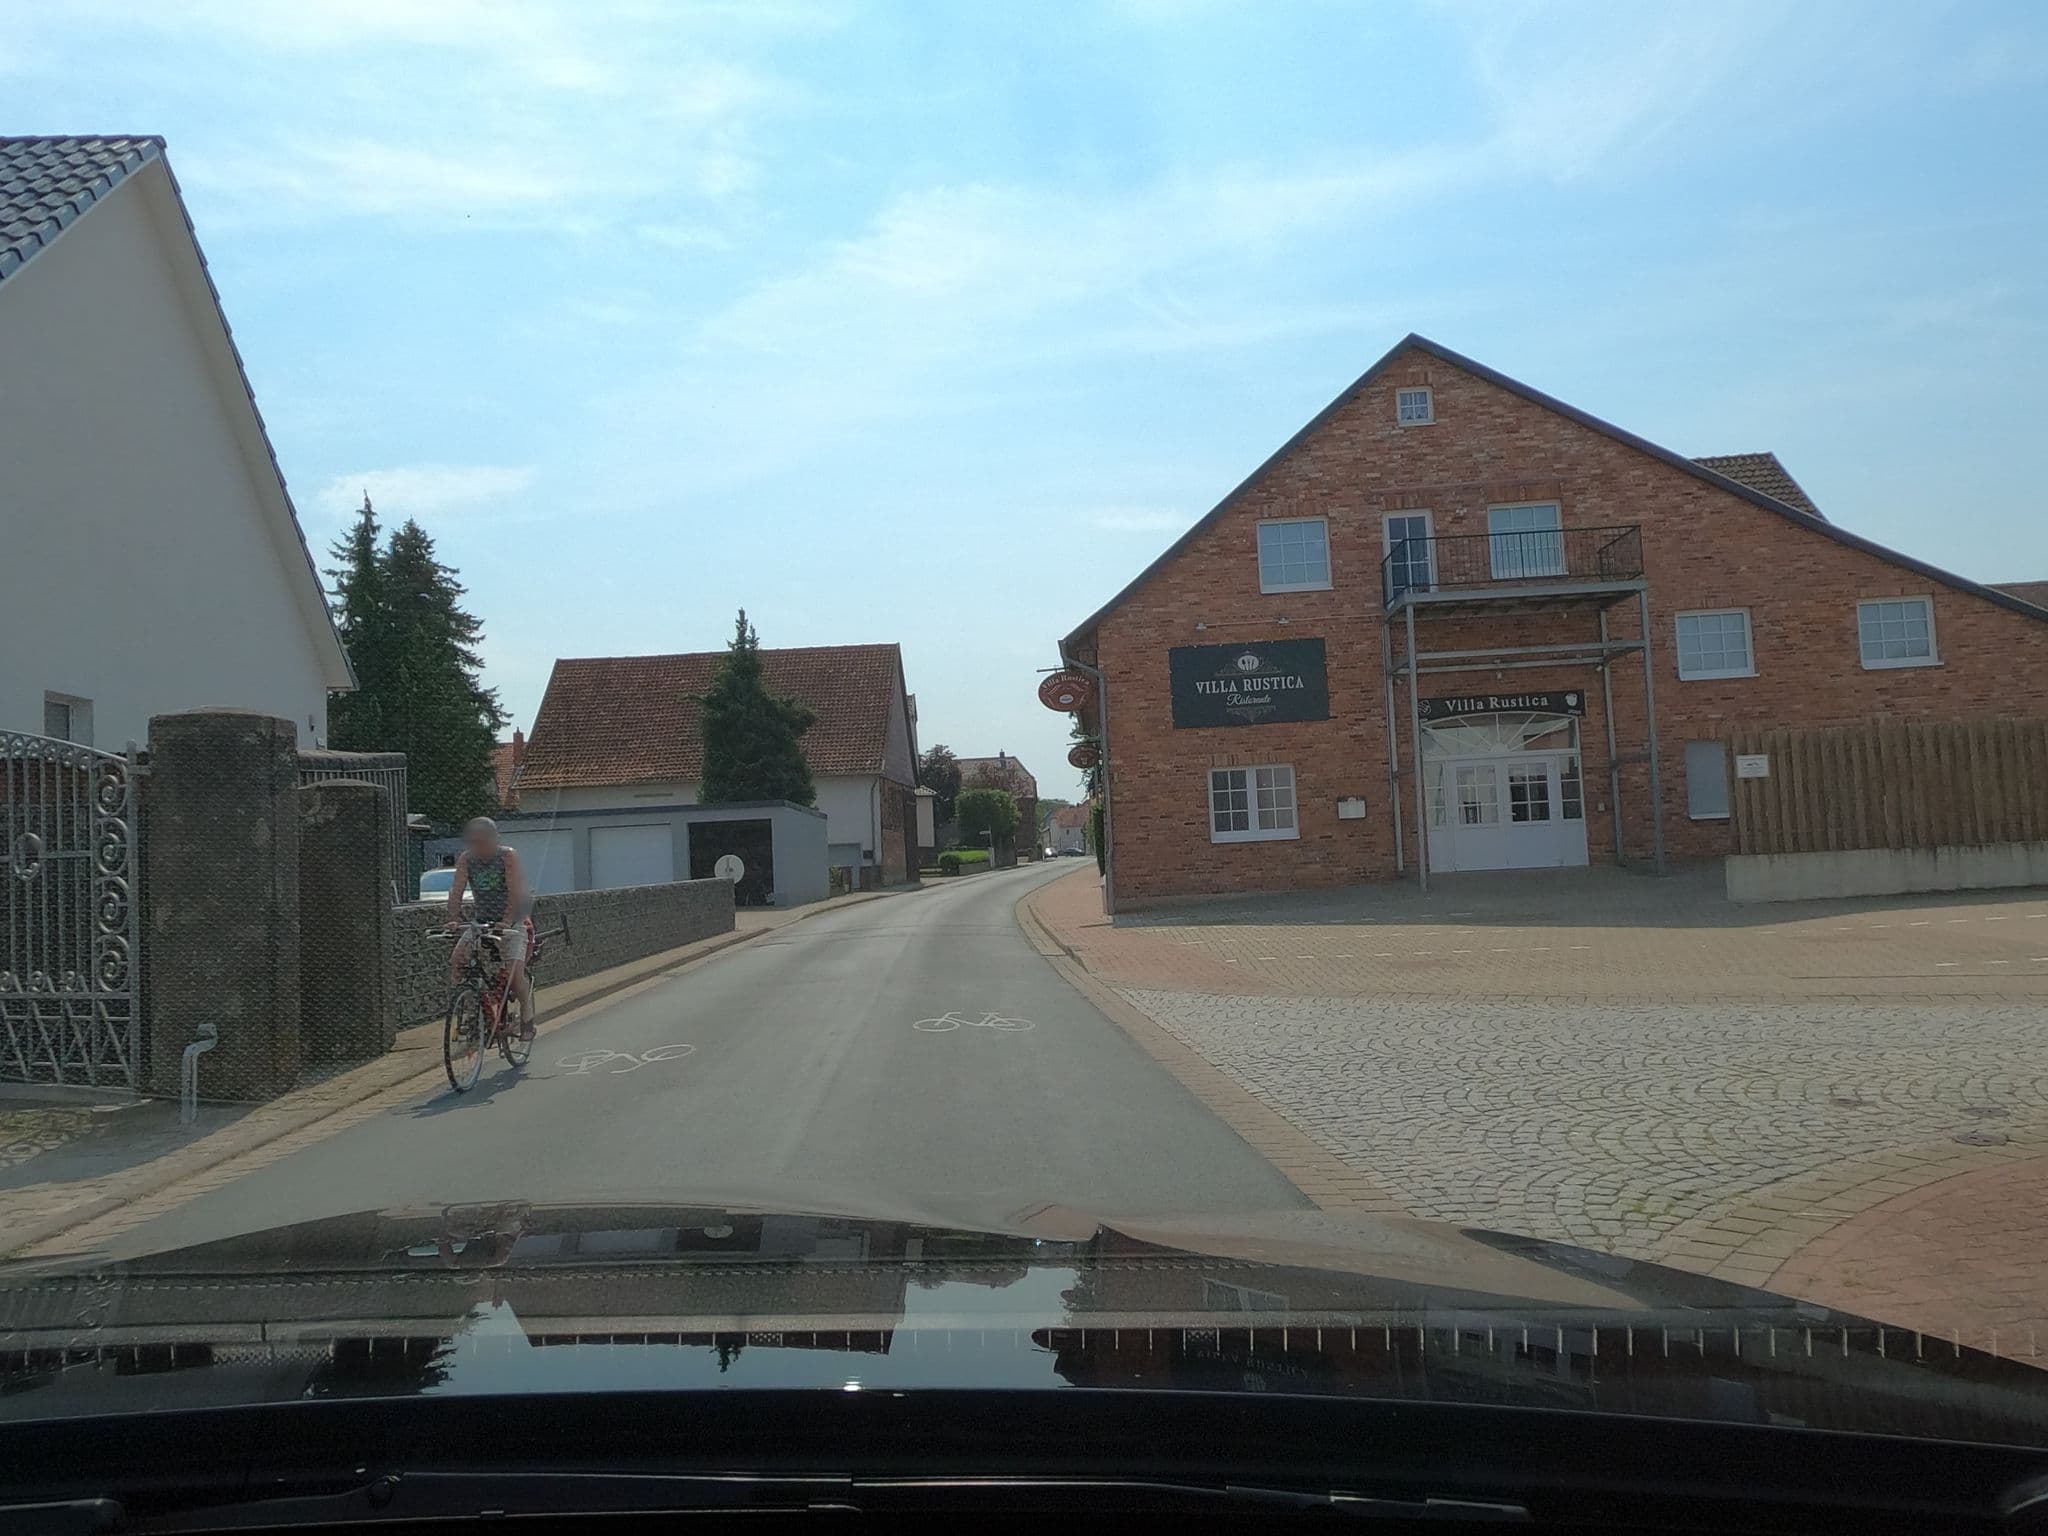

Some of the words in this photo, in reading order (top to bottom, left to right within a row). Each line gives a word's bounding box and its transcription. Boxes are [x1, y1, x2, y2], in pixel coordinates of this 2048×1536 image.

[1195, 679, 1238, 694] VILLA
[1243, 675, 1305, 692] RUSTICA
[1445, 699, 1484, 712] Villa
[1489, 695, 1549, 709] Rustica
